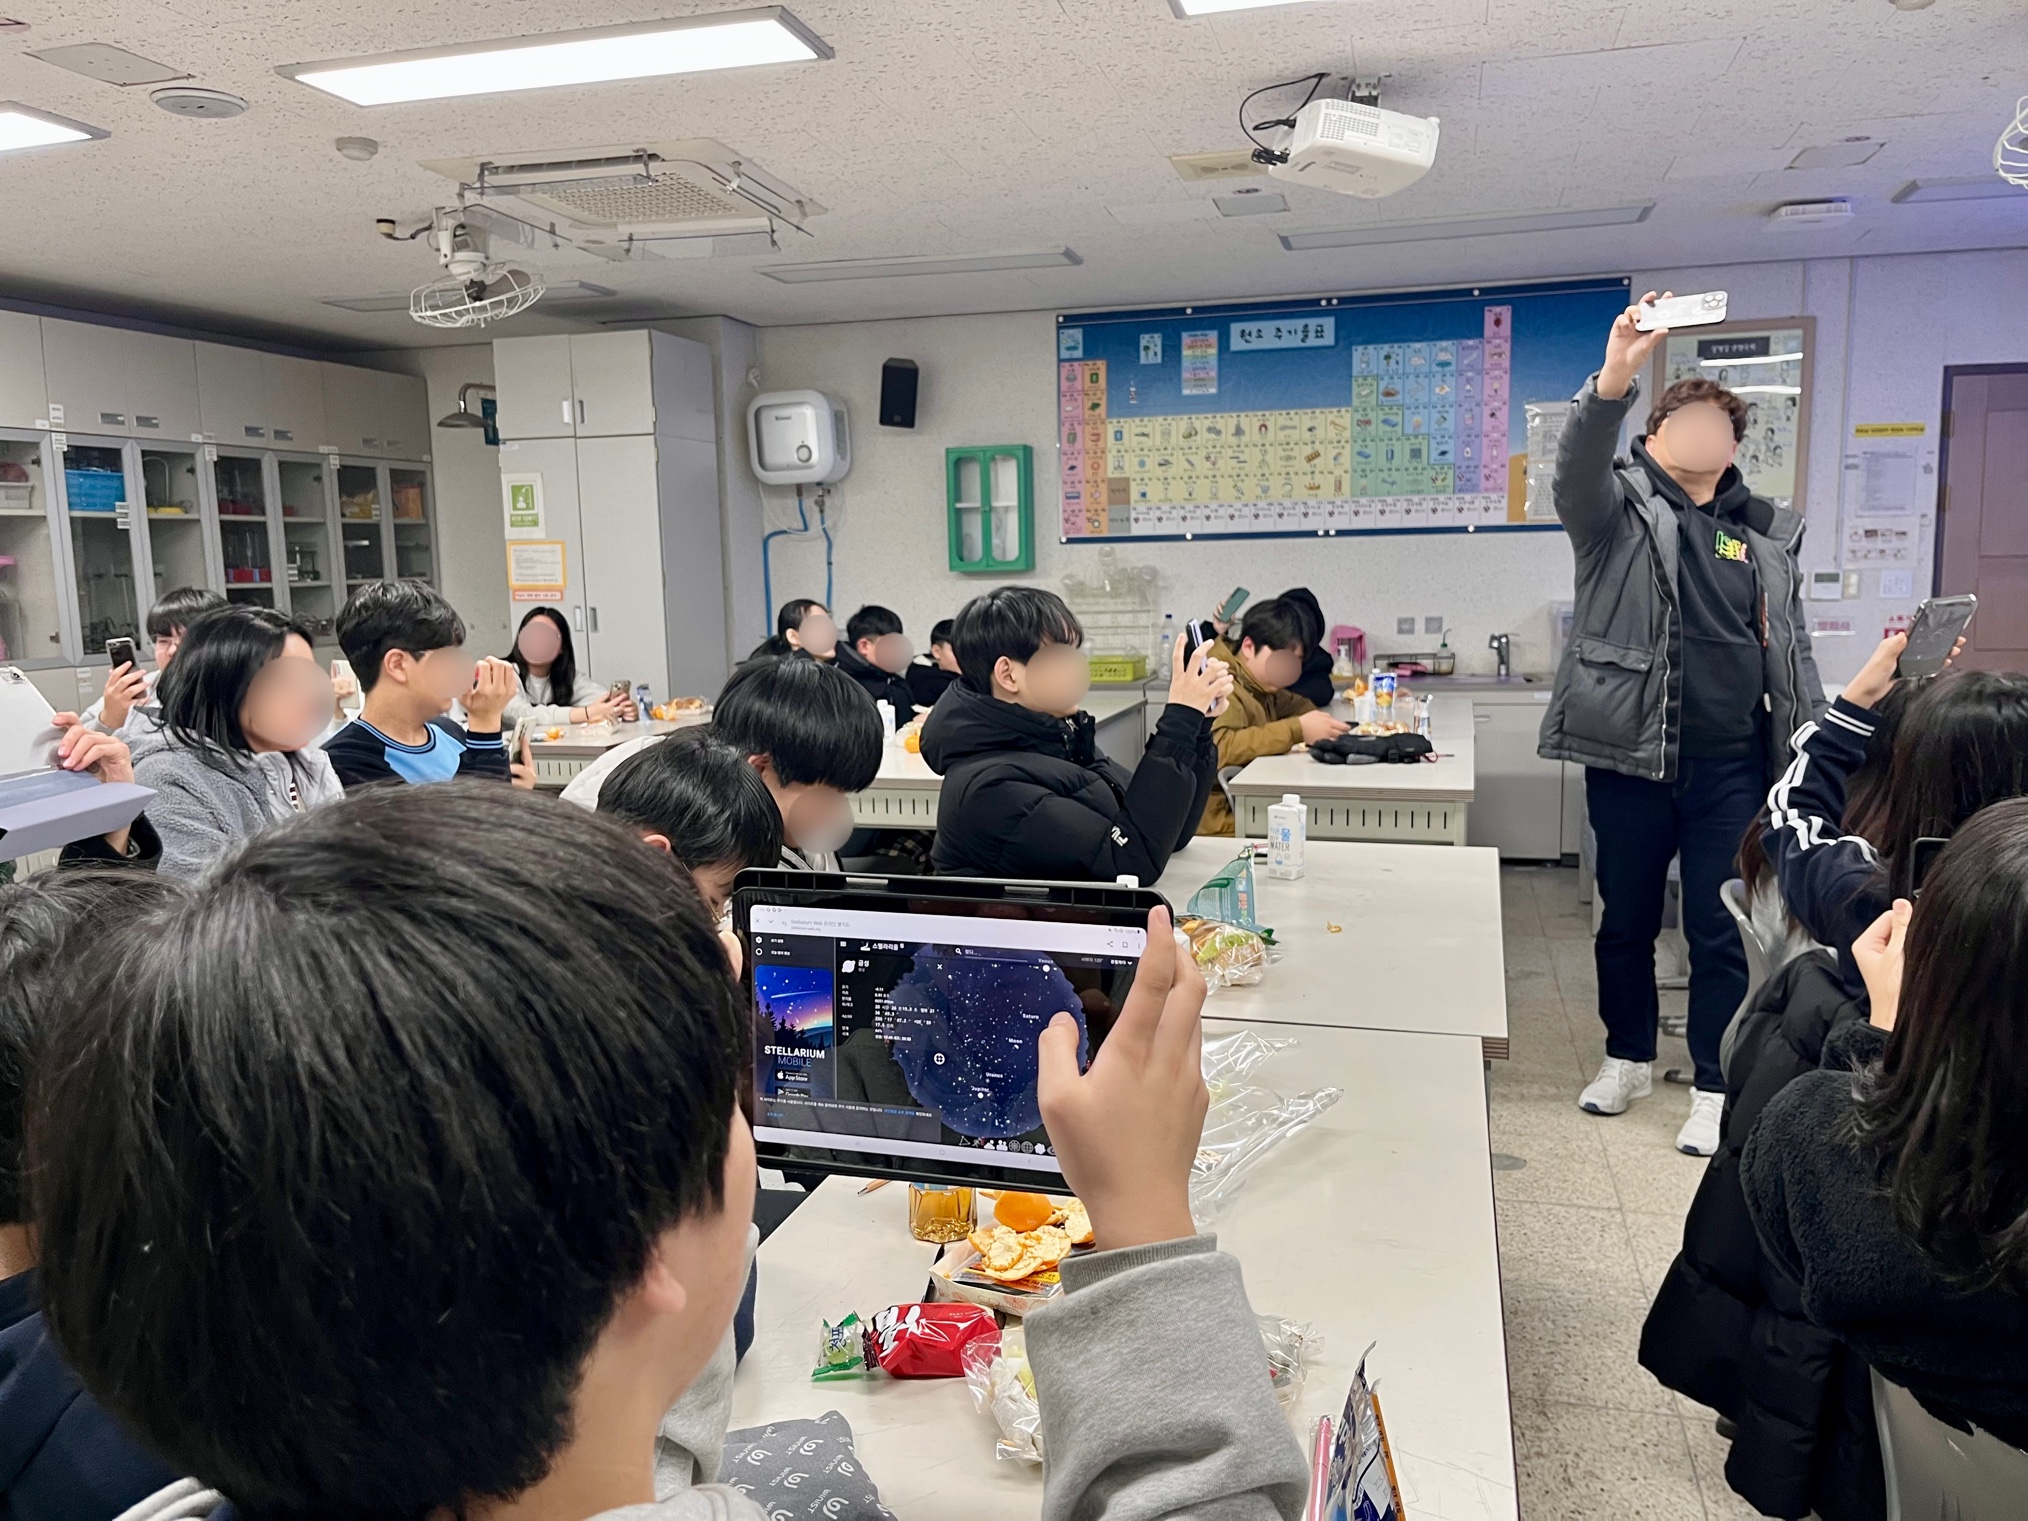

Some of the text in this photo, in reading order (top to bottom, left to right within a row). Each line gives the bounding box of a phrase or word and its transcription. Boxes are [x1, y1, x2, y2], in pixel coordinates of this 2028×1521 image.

[1270, 841, 1290, 852] WATER
[764, 1045, 825, 1059] STELLARIUM
[778, 1056, 812, 1067] MOBILE
